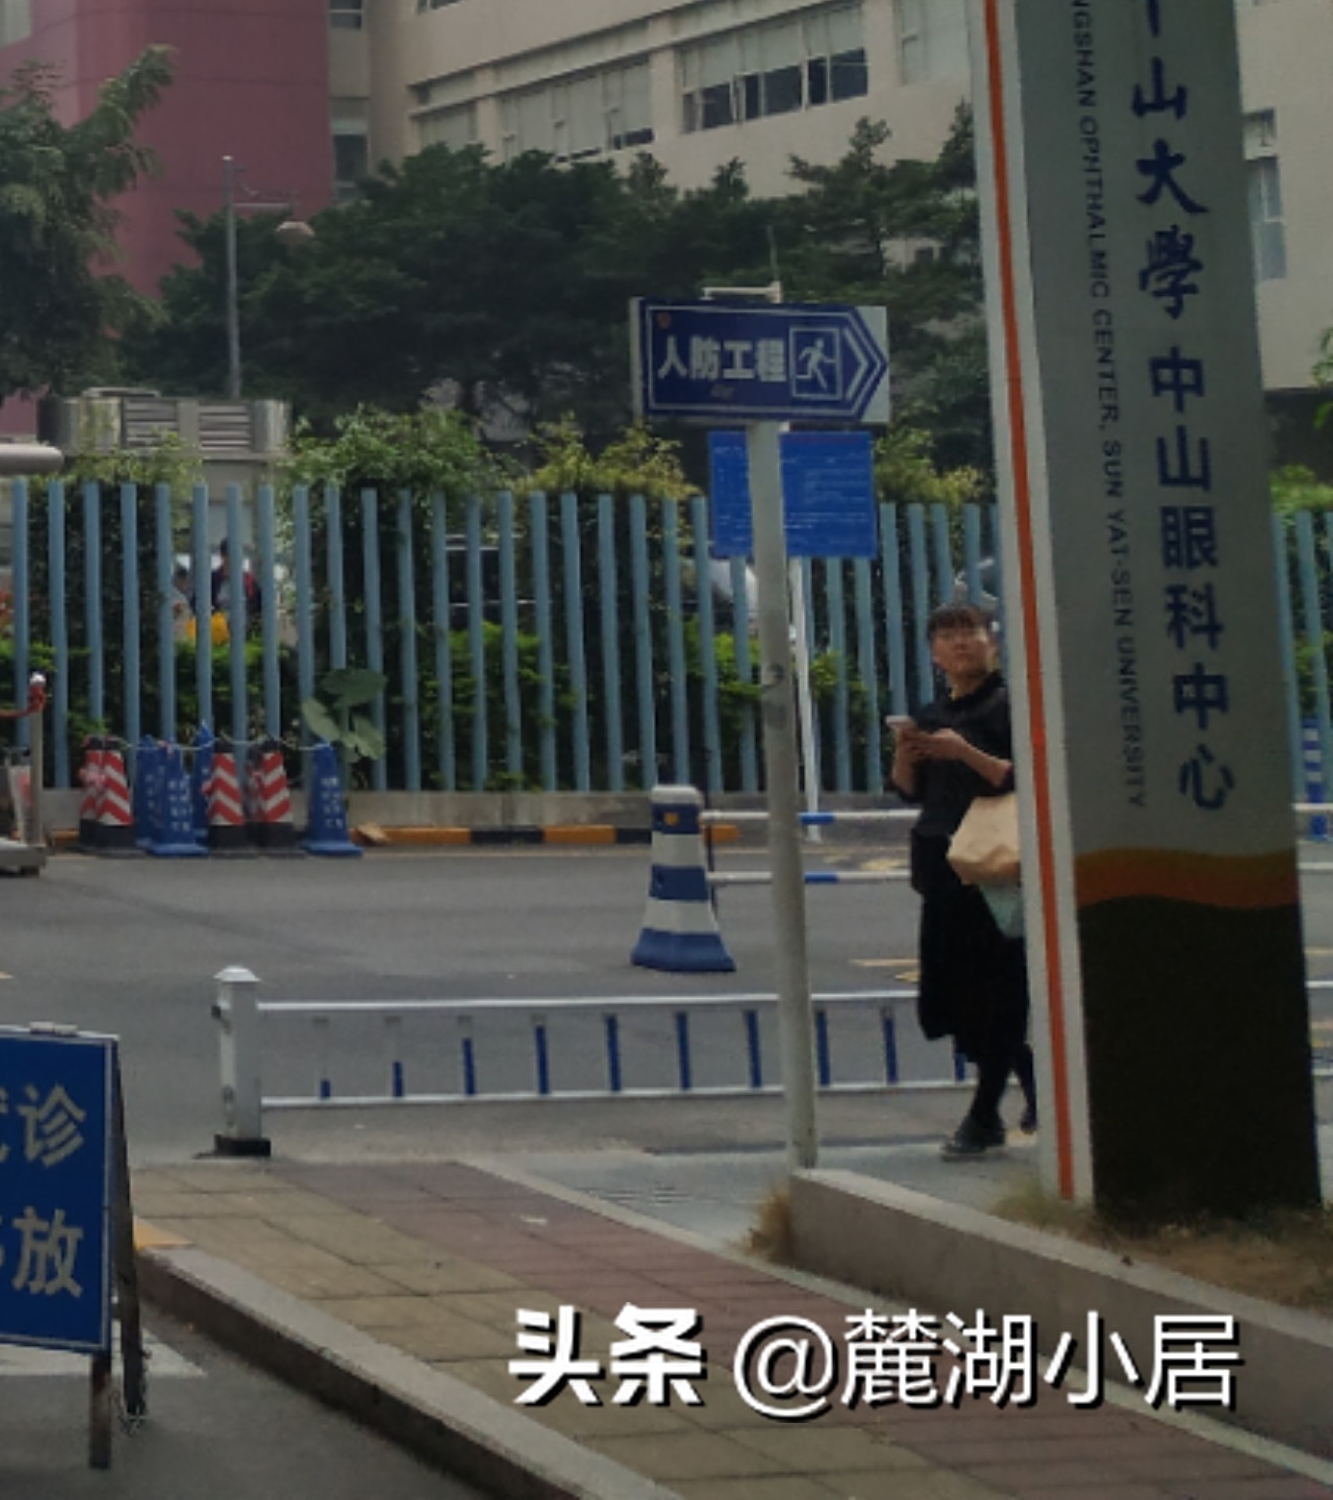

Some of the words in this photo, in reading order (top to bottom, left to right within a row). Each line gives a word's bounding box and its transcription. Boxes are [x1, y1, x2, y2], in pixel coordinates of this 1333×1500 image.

[1079, 116, 1110, 300] OPHTHALMIC
[658, 335, 787, 383] 人防工程
[1093, 309, 1120, 432] CENTER,
[1101, 440, 1126, 498] SUN
[1107, 508, 1133, 627] YAT-SEN
[1116, 637, 1146, 808] UNIVERSITY
